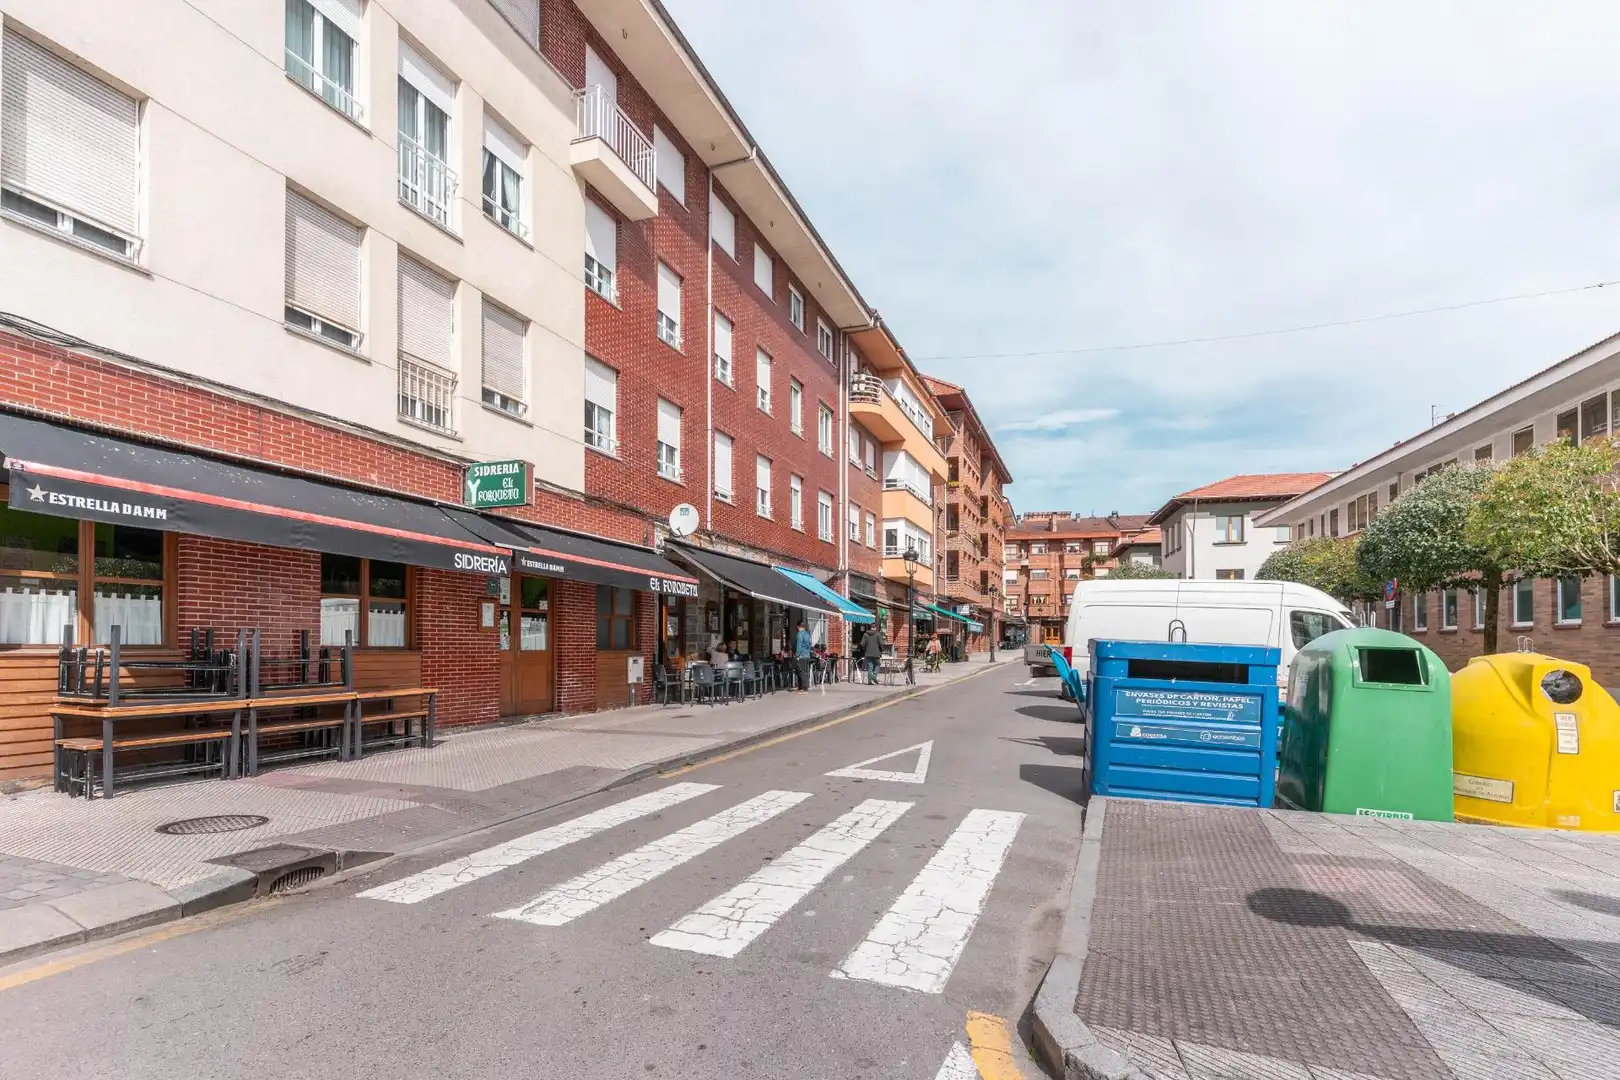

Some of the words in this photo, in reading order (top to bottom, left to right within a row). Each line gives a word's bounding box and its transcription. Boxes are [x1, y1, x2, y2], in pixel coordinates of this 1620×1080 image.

[474, 463, 520, 477] SIDRERIA
[49, 492, 120, 514] ESTRELLA
[122, 503, 168, 520] DAMM
[454, 553, 508, 575] SIDRERÍA
[526, 560, 549, 570] ESTRELLA
[1125, 691, 1165, 699] ENVASES
[1136, 698, 1190, 706] PERIÓDICOS
[1200, 701, 1244, 709] REVISTAS
